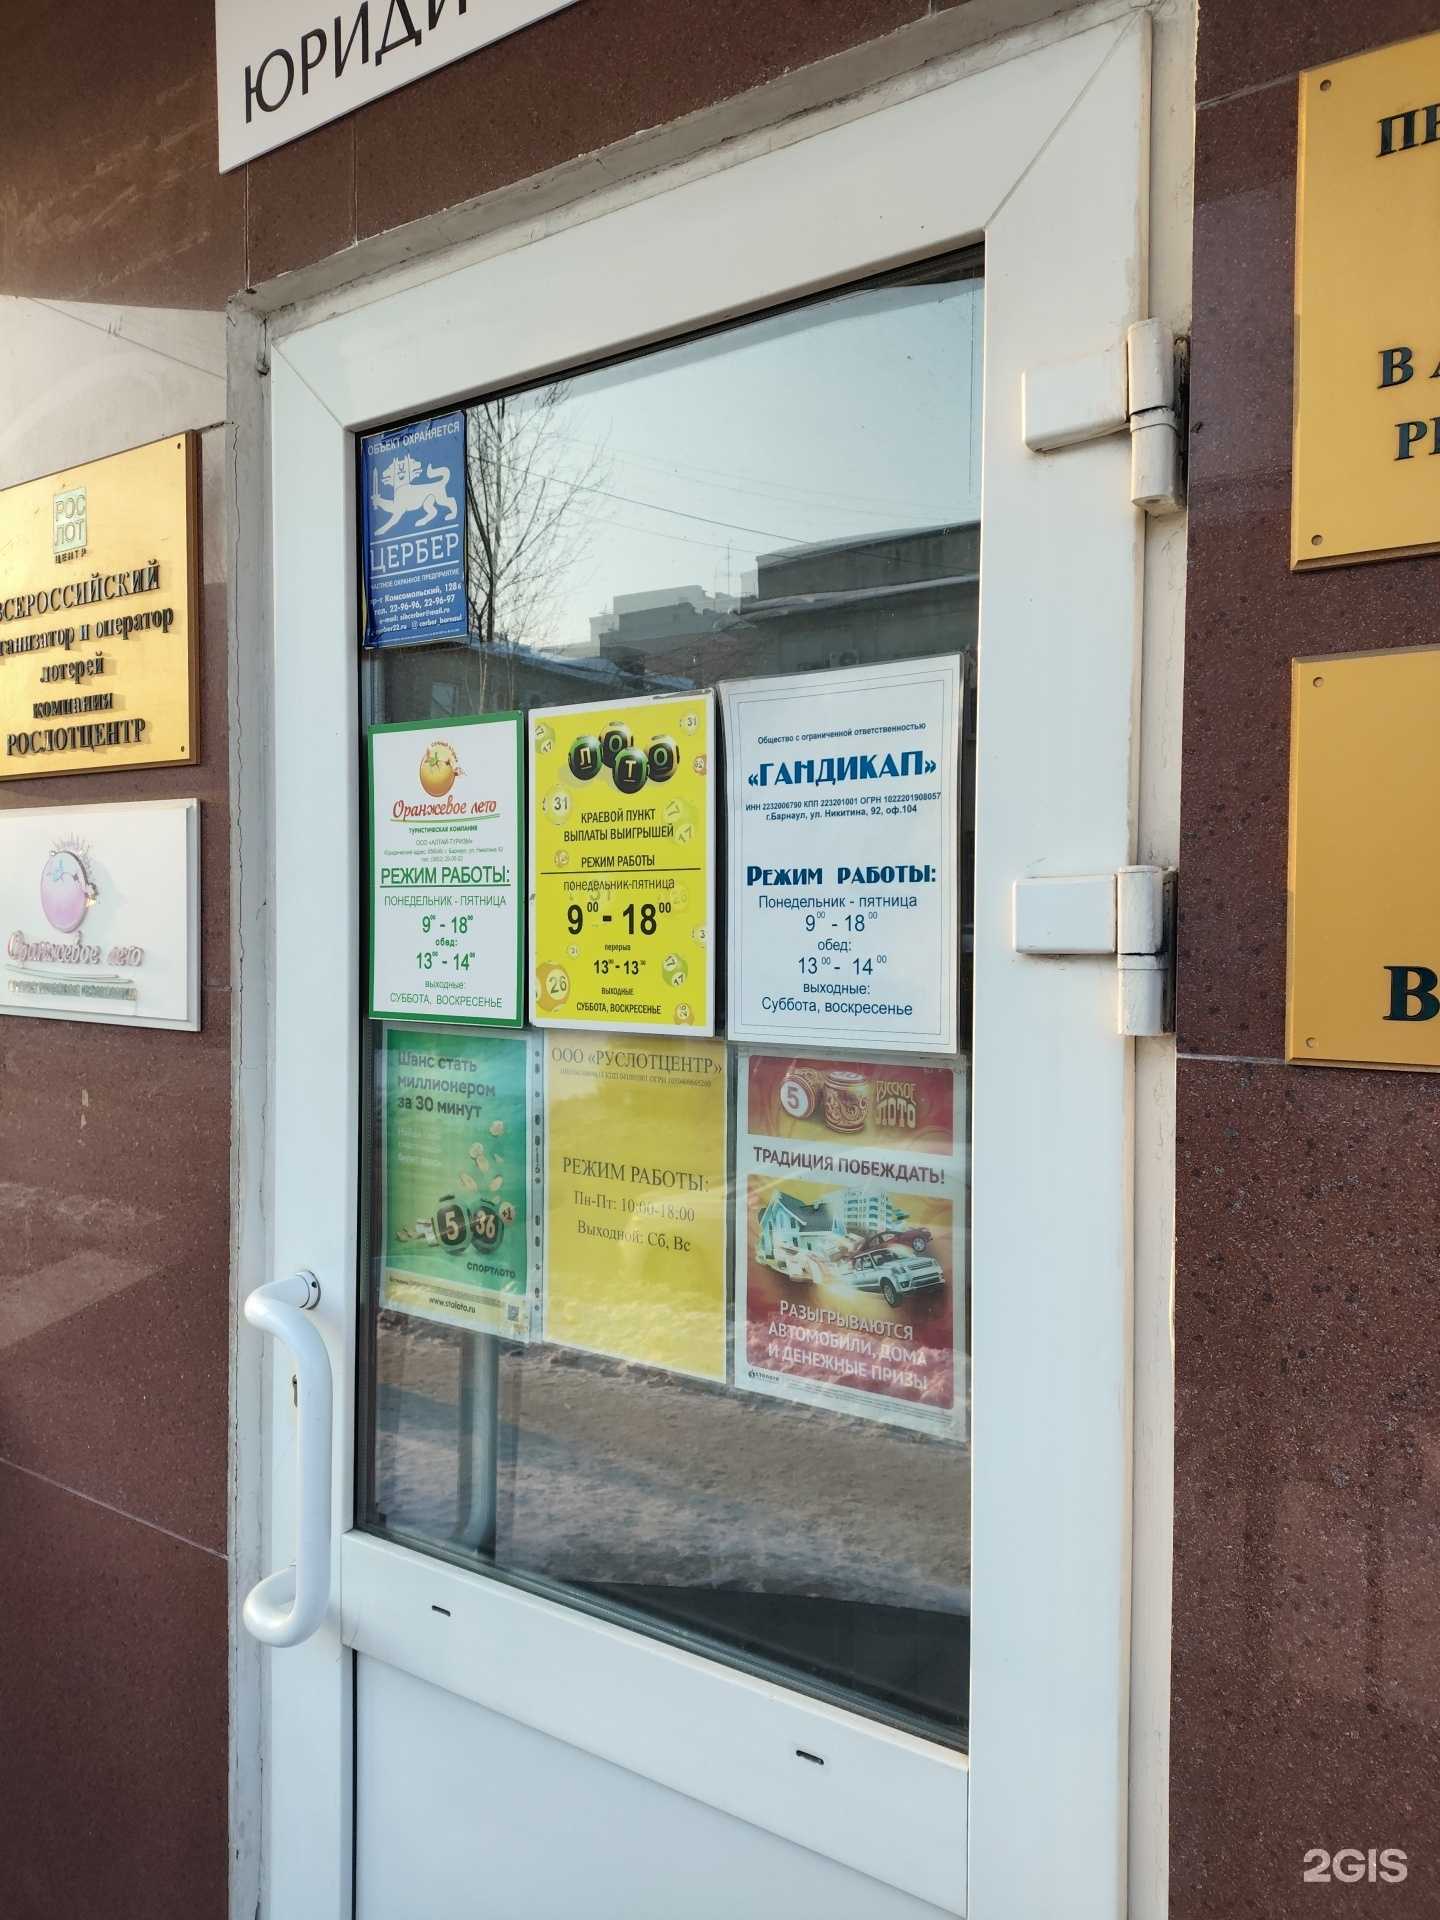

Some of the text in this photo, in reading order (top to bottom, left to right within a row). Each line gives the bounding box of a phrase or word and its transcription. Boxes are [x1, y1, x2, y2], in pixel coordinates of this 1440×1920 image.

[367, 421, 460, 456] ОБЪЕКТ ОХРАНЯЕТСЯ
[55, 494, 87, 521] РОС
[54, 520, 84, 546] ЛОТ
[55, 548, 87, 564] ЦЕНТР
[370, 533, 459, 573] ЦЕРБЕР
[421, 567, 460, 581] ПРЕДПРИЯТИЕ
[384, 587, 442, 602] Комсомольский,
[389, 601, 422, 613] 22-96-96,
[424, 594, 456, 607] 22-96-97
[79, 624, 90, 642] и
[96, 607, 174, 640] оператор
[40, 651, 105, 684] лотерей
[33, 692, 114, 719] компании
[7, 718, 147, 756] РОСЛОТЦЕНТР
[757, 735, 794, 746] Общество
[801, 728, 853, 742] ограниченной
[854, 721, 926, 736] ответственностью
[748, 750, 937, 787] «ГАНДИКАП»
[392, 795, 497, 822] Оранжевое лето
[745, 803, 761, 811] ИНН
[803, 799, 819, 808] КПП
[820, 797, 858, 807] 223201001
[860, 796, 882, 805] ОГРН
[766, 811, 808, 822] г.Барнаул,
[810, 810, 823, 820] ул.
[824, 807, 868, 818] Никитина,
[870, 806, 883, 816] 92,
[581, 807, 656, 824] КРАЕВОЙ ПУНКТ
[449, 825, 478, 833] КОМПАНИЯ
[564, 822, 674, 842] ВЫПЛАТЫ ВЫИГРЫШЕЙ
[581, 855, 615, 868] РЕЖИМ
[617, 854, 655, 867] РАБОТЫ
[381, 865, 511, 885] РЕЖИМ РАБОТЫ:
[563, 878, 675, 891] понедельник-пятница
[384, 895, 453, 907] ПОНЕДЕЛЬНИК
[460, 895, 507, 907] ПЯТНИЦА
[758, 896, 846, 910] Понедельник
[859, 895, 918, 909] пятница
[435, 938, 458, 947] обед:
[604, 943, 631, 952] перерыв
[817, 938, 852, 952] обед:
[424, 980, 467, 989] выходные:
[549, 975, 567, 994] 26
[803, 982, 871, 995] выходные:
[390, 993, 503, 1008] СУББОТА, ВОСКРЕСЕНЬЕ
[576, 1002, 661, 1015] СУББОТА, ВОСКРЕСЕНЬЕ
[761, 996, 913, 1016] Суббота, воскресенье
[398, 1051, 478, 1073] Шанс стать
[551, 1047, 584, 1064] ООО
[587, 1048, 723, 1075] «РУСЛОТЦЕНТР»
[398, 1075, 496, 1098] миллионером
[786, 1084, 800, 1110] 5
[875, 1080, 919, 1105] РУССКОЕ
[397, 1095, 483, 1120] за 30 минут
[874, 1098, 917, 1129] ЛОТО
[562, 1156, 710, 1193] РЕЖИМ РАБОТЫ:
[752, 1146, 945, 1185] ТРАДИЦИЯ ПОБЕЖДАТЬ!
[502, 1206, 513, 1221] +1
[573, 1190, 696, 1223] Пн-Пт: 10:00-18:00
[445, 1209, 496, 1240] 5 36
[577, 1219, 644, 1245] Выходной:
[673, 1235, 691, 1252] Вс
[466, 1261, 516, 1279] СПОРТЛОТО
[779, 1300, 914, 1341] РАЗЫГРЫВАЮТСЯ
[768, 1320, 928, 1366] АВТОМОБИЛИ, ДОМА
[768, 1343, 929, 1391] И ДЕНЕЖНЫЕ ПРИЗЫ
